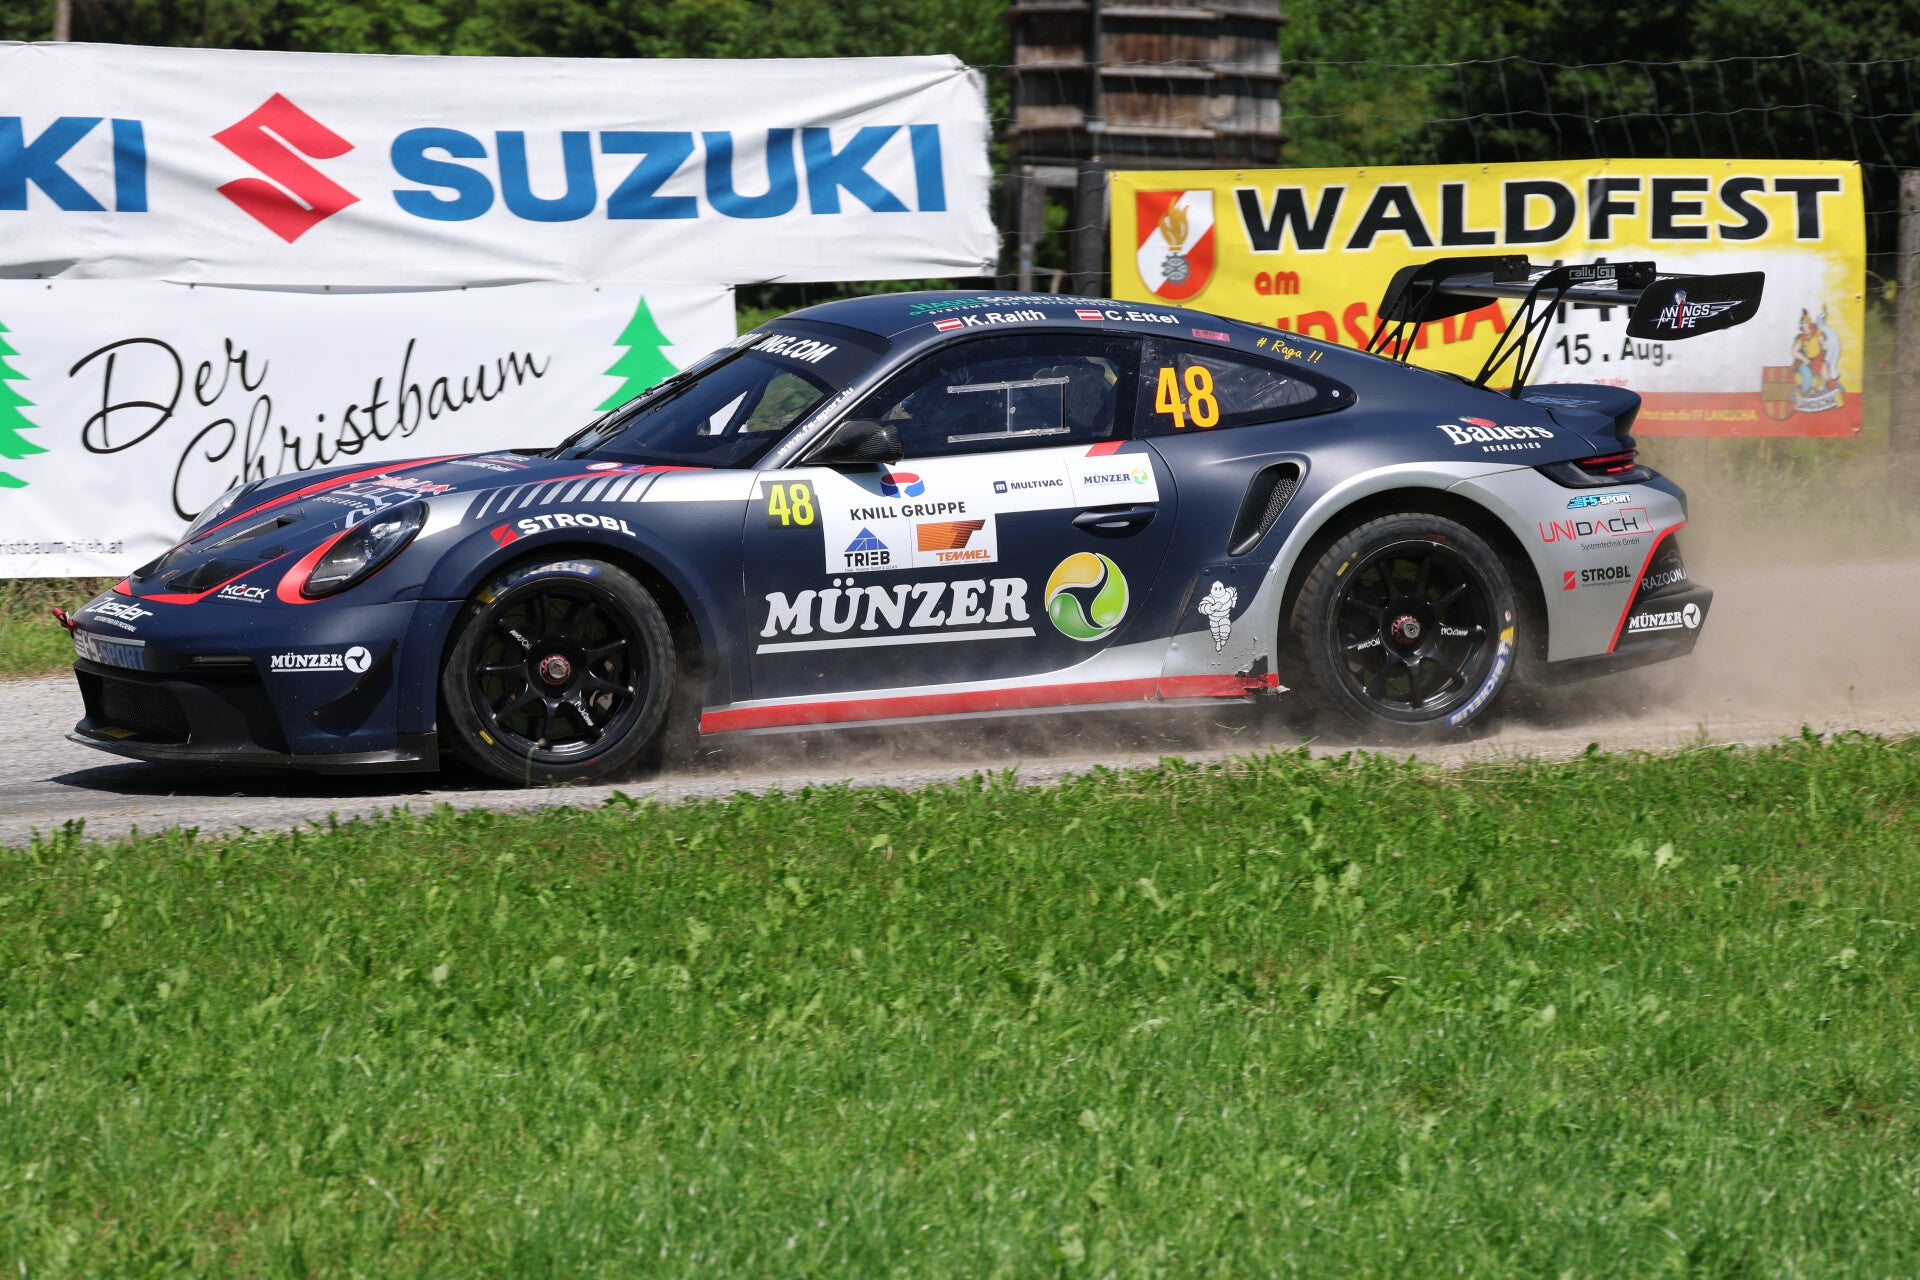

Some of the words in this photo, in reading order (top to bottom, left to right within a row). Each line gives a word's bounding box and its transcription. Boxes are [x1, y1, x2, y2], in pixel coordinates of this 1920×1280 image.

[0, 116, 148, 212] KI
[390, 124, 947, 223] SUZUKI
[1236, 177, 1841, 251] WALDFEST
[1255, 271, 1299, 295] am
[961, 309, 1047, 327] K.Raith
[1105, 310, 1180, 325] C.Ettel
[1665, 304, 1710, 318] WINGS
[1671, 317, 1697, 329] LIFE
[1271, 340, 1303, 360] Raga
[1307, 350, 1324, 363] !!
[1619, 336, 1672, 367] Aug.
[70, 337, 270, 454] Der
[1154, 365, 1220, 429] 48
[173, 337, 551, 522] Christbaum
[1436, 424, 1554, 446] Bauers
[1482, 442, 1542, 453] BEERADIES
[1010, 479, 1064, 490] MULTIVAC
[1083, 473, 1131, 485] MÜNZER
[768, 483, 815, 526] 48
[850, 506, 898, 521] KNILL
[901, 501, 967, 518] GRUPPE
[517, 513, 637, 537] STROBL
[1539, 516, 1640, 543] UNIDACH
[1580, 539, 1621, 551] Systemtechnik
[1622, 537, 1640, 547] GmbH
[844, 551, 891, 567] TRIEB
[935, 549, 991, 562] TEMMEL
[1581, 565, 1632, 583] STROBL
[220, 583, 270, 599] KÖCK
[760, 577, 1030, 638] MÜNZER
[1628, 611, 1684, 630] MÜNZER
[270, 652, 343, 669] MÜNZER
